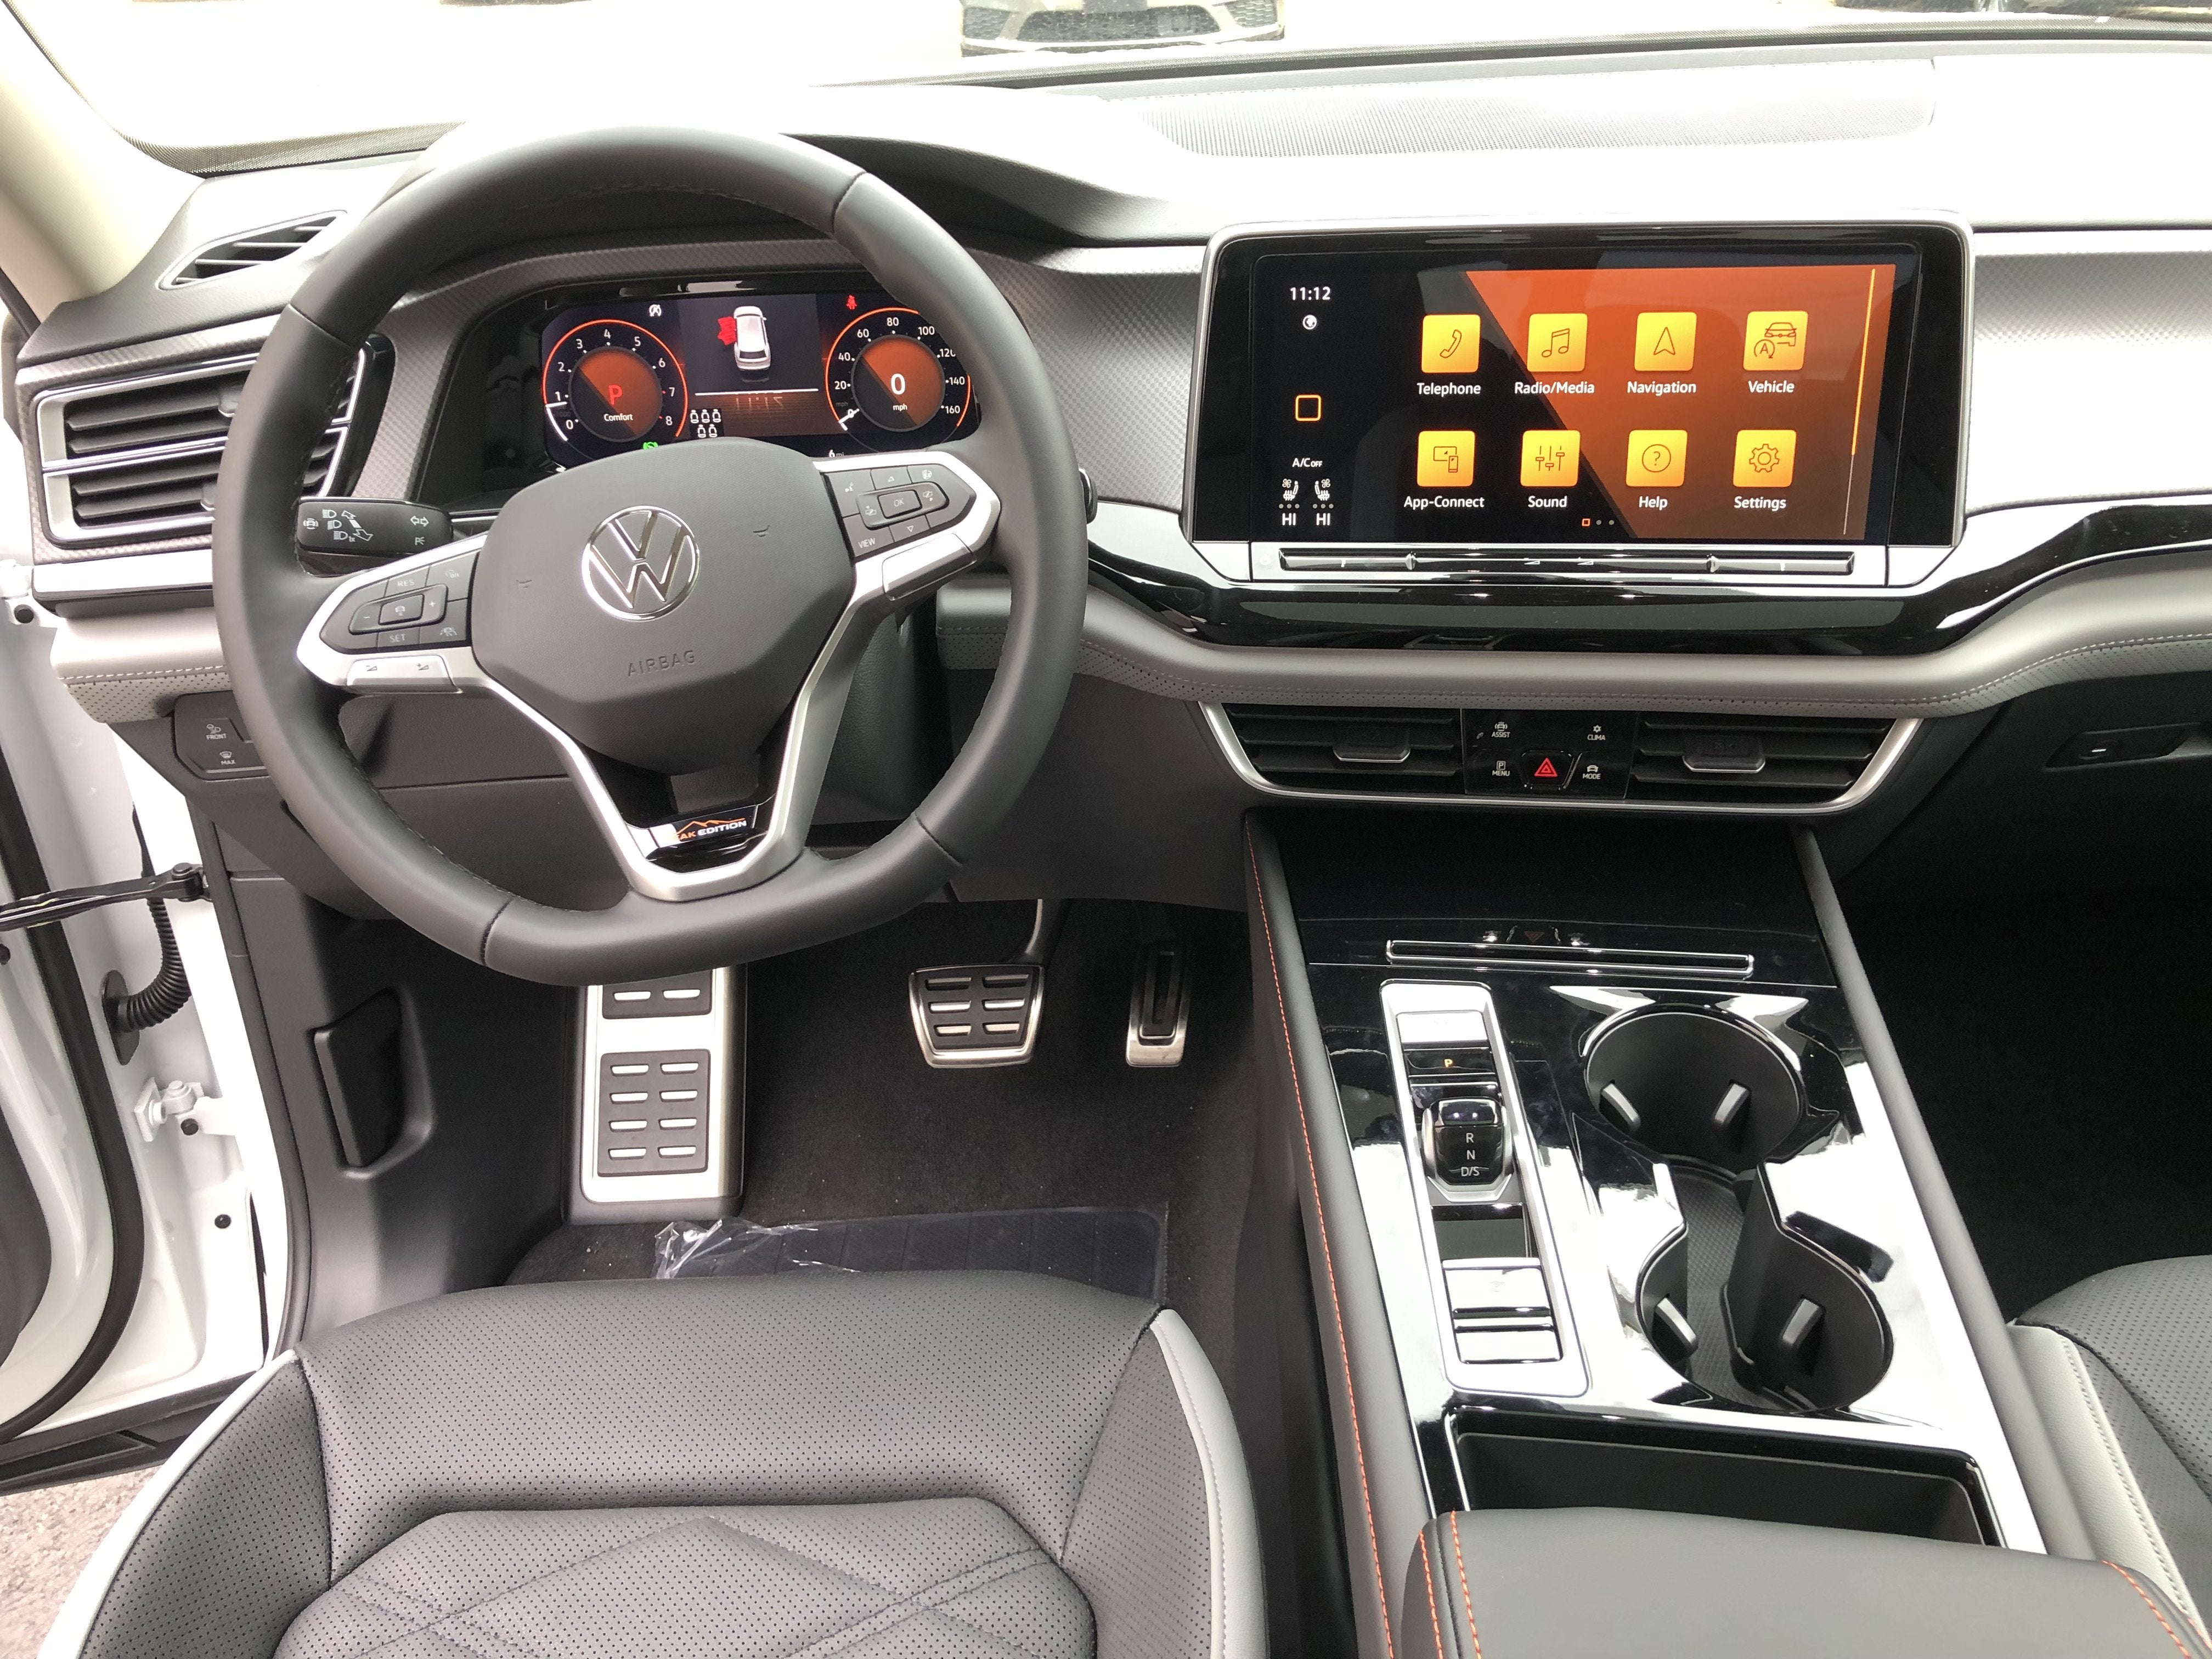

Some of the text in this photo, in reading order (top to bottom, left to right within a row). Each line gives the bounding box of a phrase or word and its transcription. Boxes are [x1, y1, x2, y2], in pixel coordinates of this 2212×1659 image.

[1290, 286, 1330, 301] 11:12
[887, 317, 899, 326] 80
[603, 330, 610, 338] 4
[857, 329, 869, 338] 60
[918, 326, 935, 335] 100
[576, 339, 583, 348] 3
[635, 337, 641, 346] 5
[838, 352, 850, 361] 40
[558, 362, 565, 371] 2
[659, 358, 665, 368] 6
[834, 380, 847, 390] 20
[890, 374, 905, 395] 0
[949, 376, 965, 385] 140
[1417, 382, 1481, 397] Telephone
[1515, 381, 1595, 394] Radio/Media
[1627, 381, 1696, 396] Navigation
[1748, 380, 1795, 393] Vehicle
[555, 391, 561, 401] 1
[608, 385, 623, 405] P
[669, 387, 675, 397] 7
[893, 403, 908, 411] mph
[945, 405, 961, 414] 160
[603, 413, 634, 422] Comfort
[665, 416, 673, 426] 8
[566, 419, 574, 430] 0
[828, 449, 836, 458] 6
[893, 498, 904, 507] OK
[1403, 495, 1485, 510] App-Connect
[1528, 495, 1567, 507] Sound
[1639, 495, 1668, 511] Help
[1734, 496, 1786, 511] Settings
[1282, 512, 1330, 526] HI HI
[858, 538, 876, 549] VIEW
[389, 634, 406, 643] SET
[628, 649, 696, 677] AIRBAG
[697, 820, 747, 836] EDITION
[1444, 1058, 1453, 1068] P
[1466, 1132, 1474, 1143] R
[1466, 1149, 1476, 1160] N
[1460, 1166, 1480, 1177] D/S
